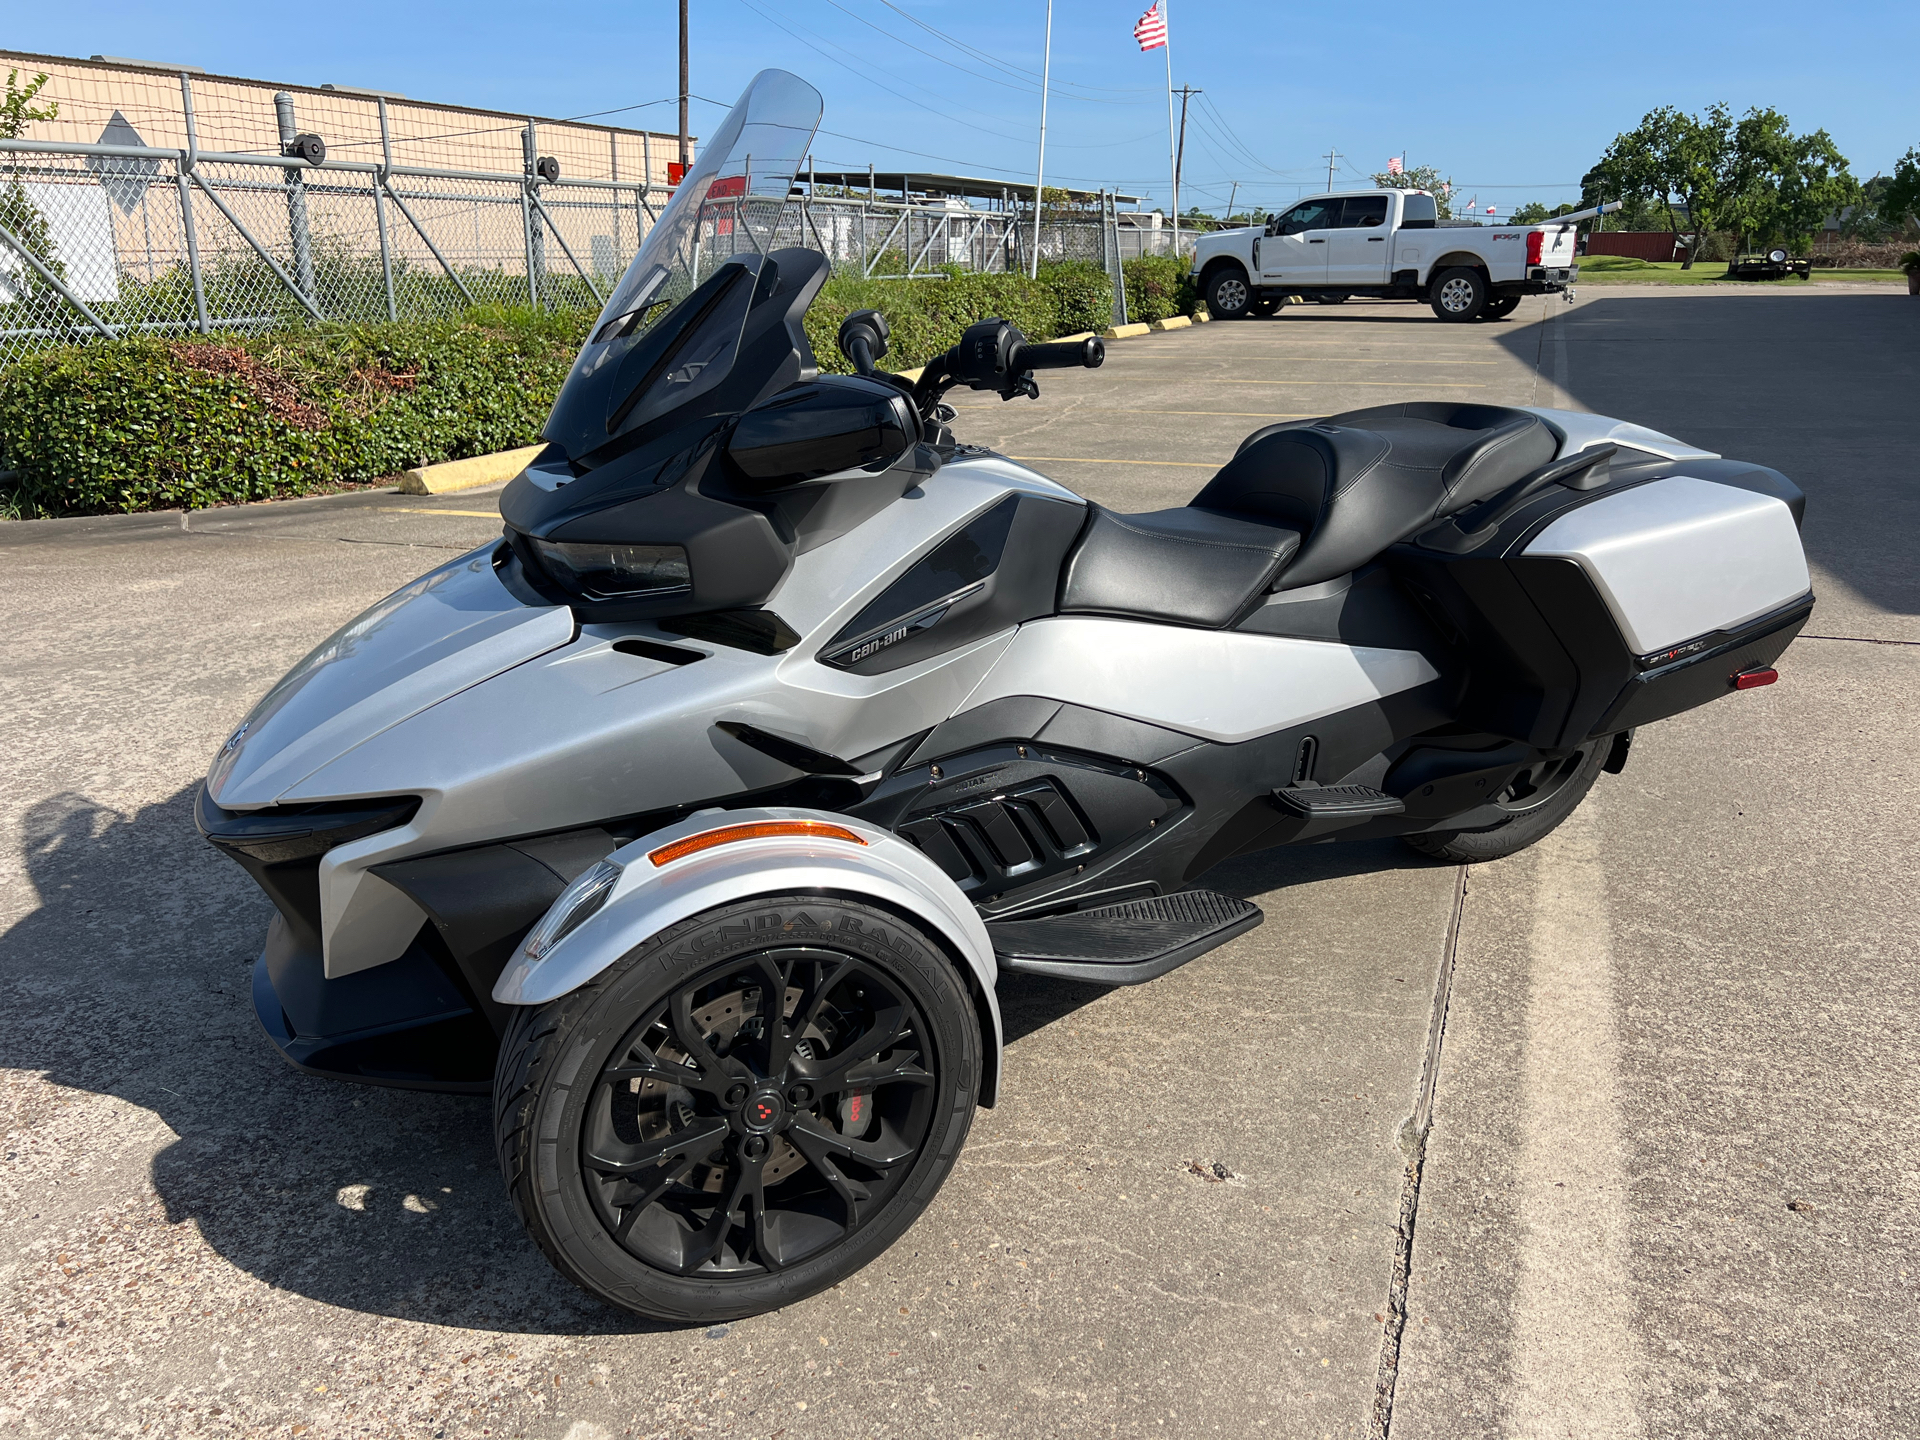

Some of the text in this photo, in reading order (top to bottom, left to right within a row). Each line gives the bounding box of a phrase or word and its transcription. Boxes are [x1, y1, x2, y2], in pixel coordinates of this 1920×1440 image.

[1493, 233, 1520, 241] FX4
[851, 626, 907, 662] can-am
[658, 911, 820, 971] KENDA
[837, 913, 950, 1005] RADIAL
